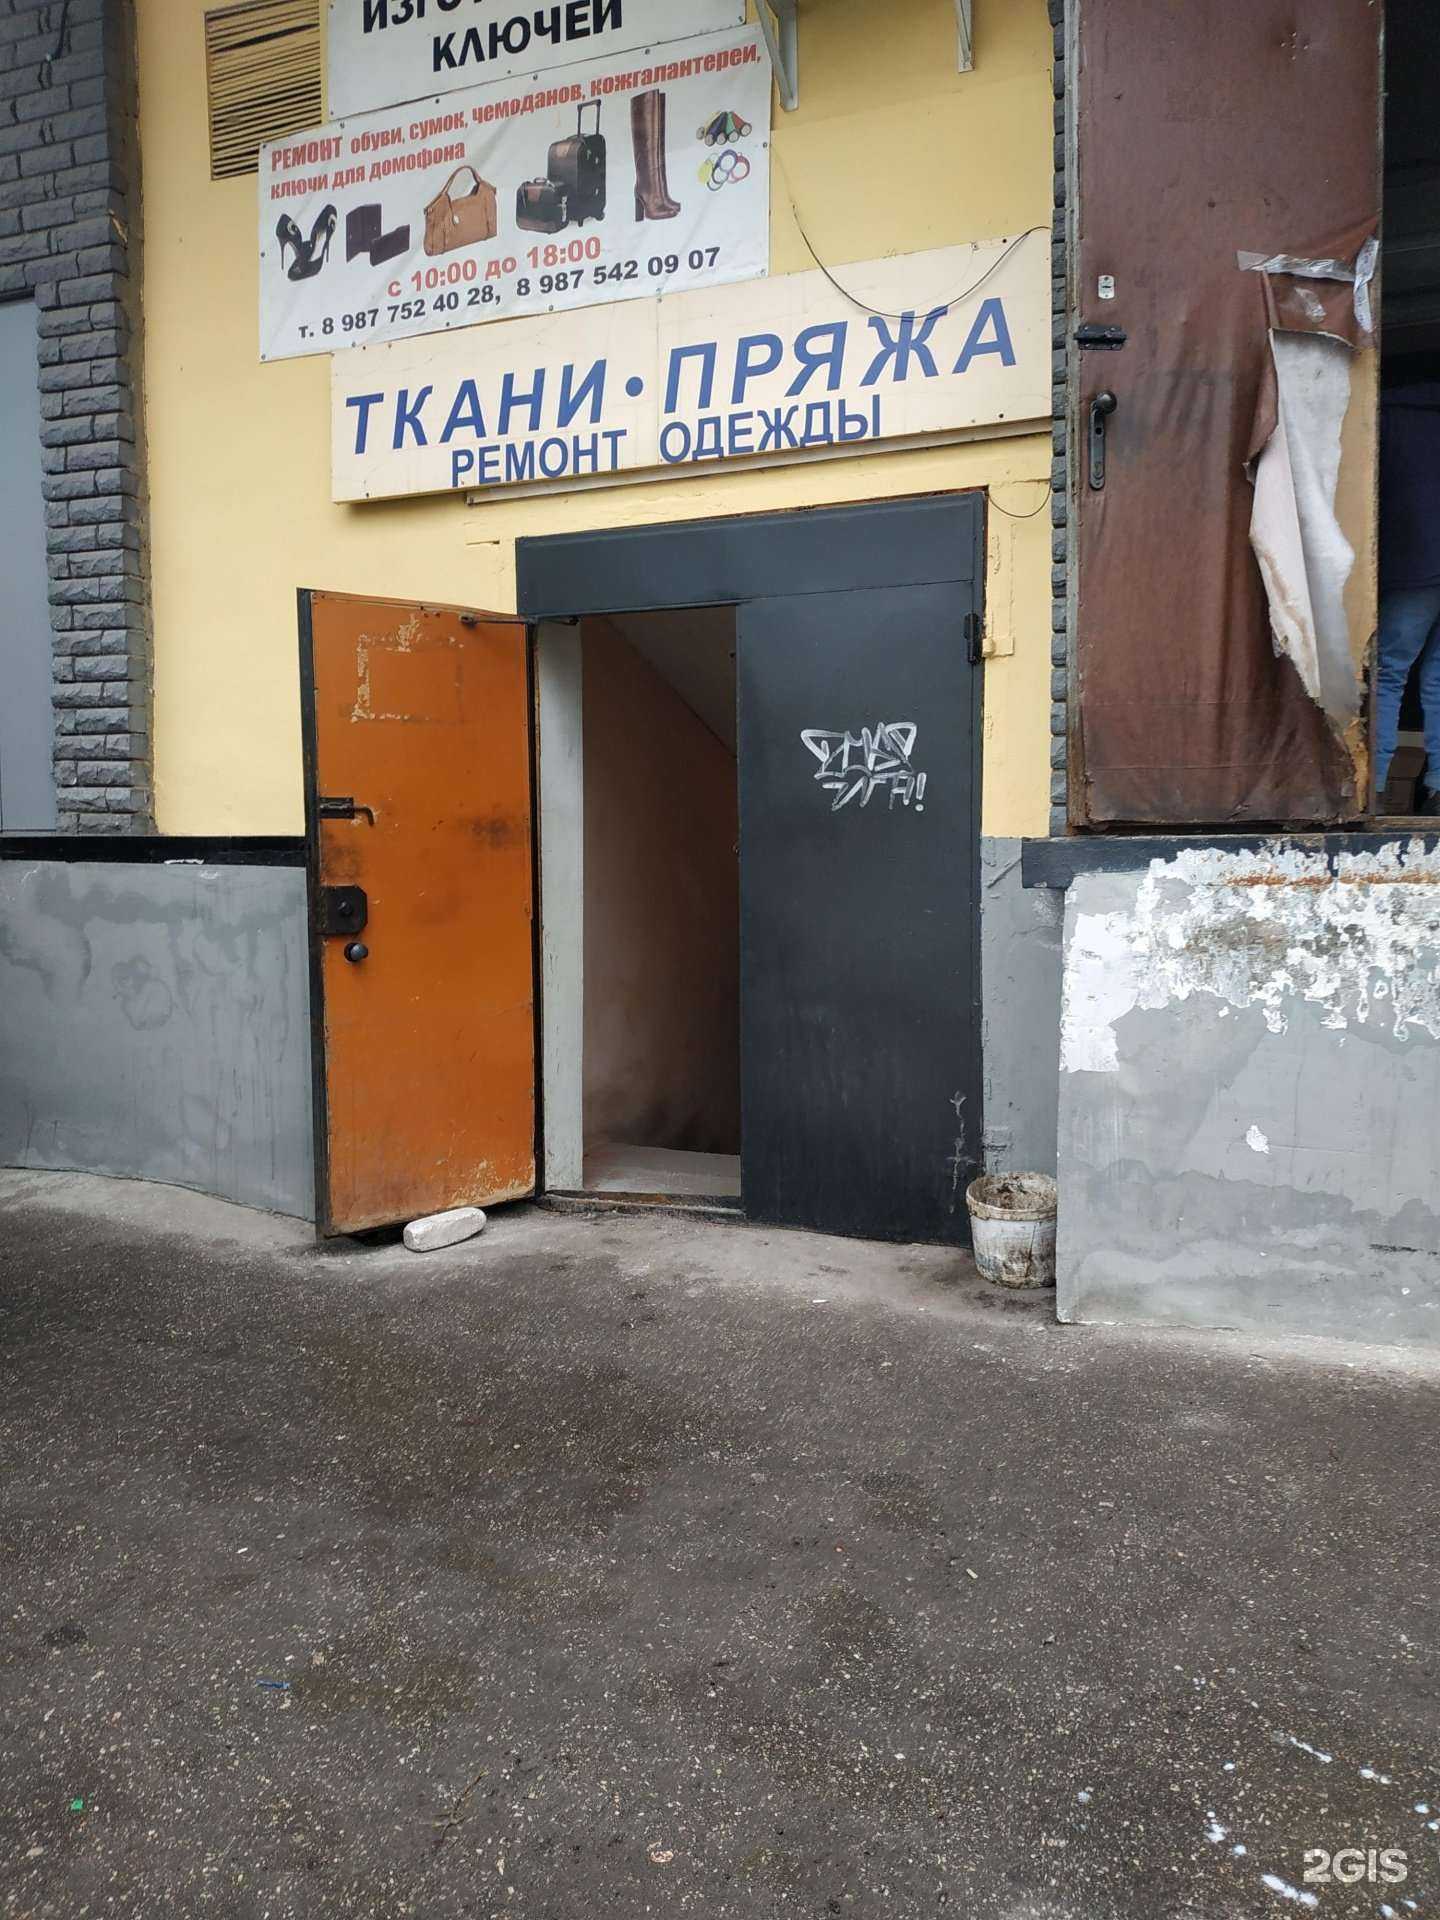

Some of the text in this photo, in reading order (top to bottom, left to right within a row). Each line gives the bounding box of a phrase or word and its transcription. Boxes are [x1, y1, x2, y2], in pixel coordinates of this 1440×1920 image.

[270, 142, 465, 200] ключи для домофона
[271, 136, 343, 171] РЕМОНТ
[350, 126, 405, 154] обуви,
[409, 110, 468, 141] сумок,
[472, 83, 585, 124] чемоданов,
[299, 246, 720, 338] т. 8 987 752 40 28, 8 987 542 09 07
[388, 236, 600, 297] с 10:00 до 18:00
[346, 297, 1016, 455] ТКАНИ ПРЯЖА
[452, 394, 880, 488] РЕМОНТ ОДЕЖДЫ
